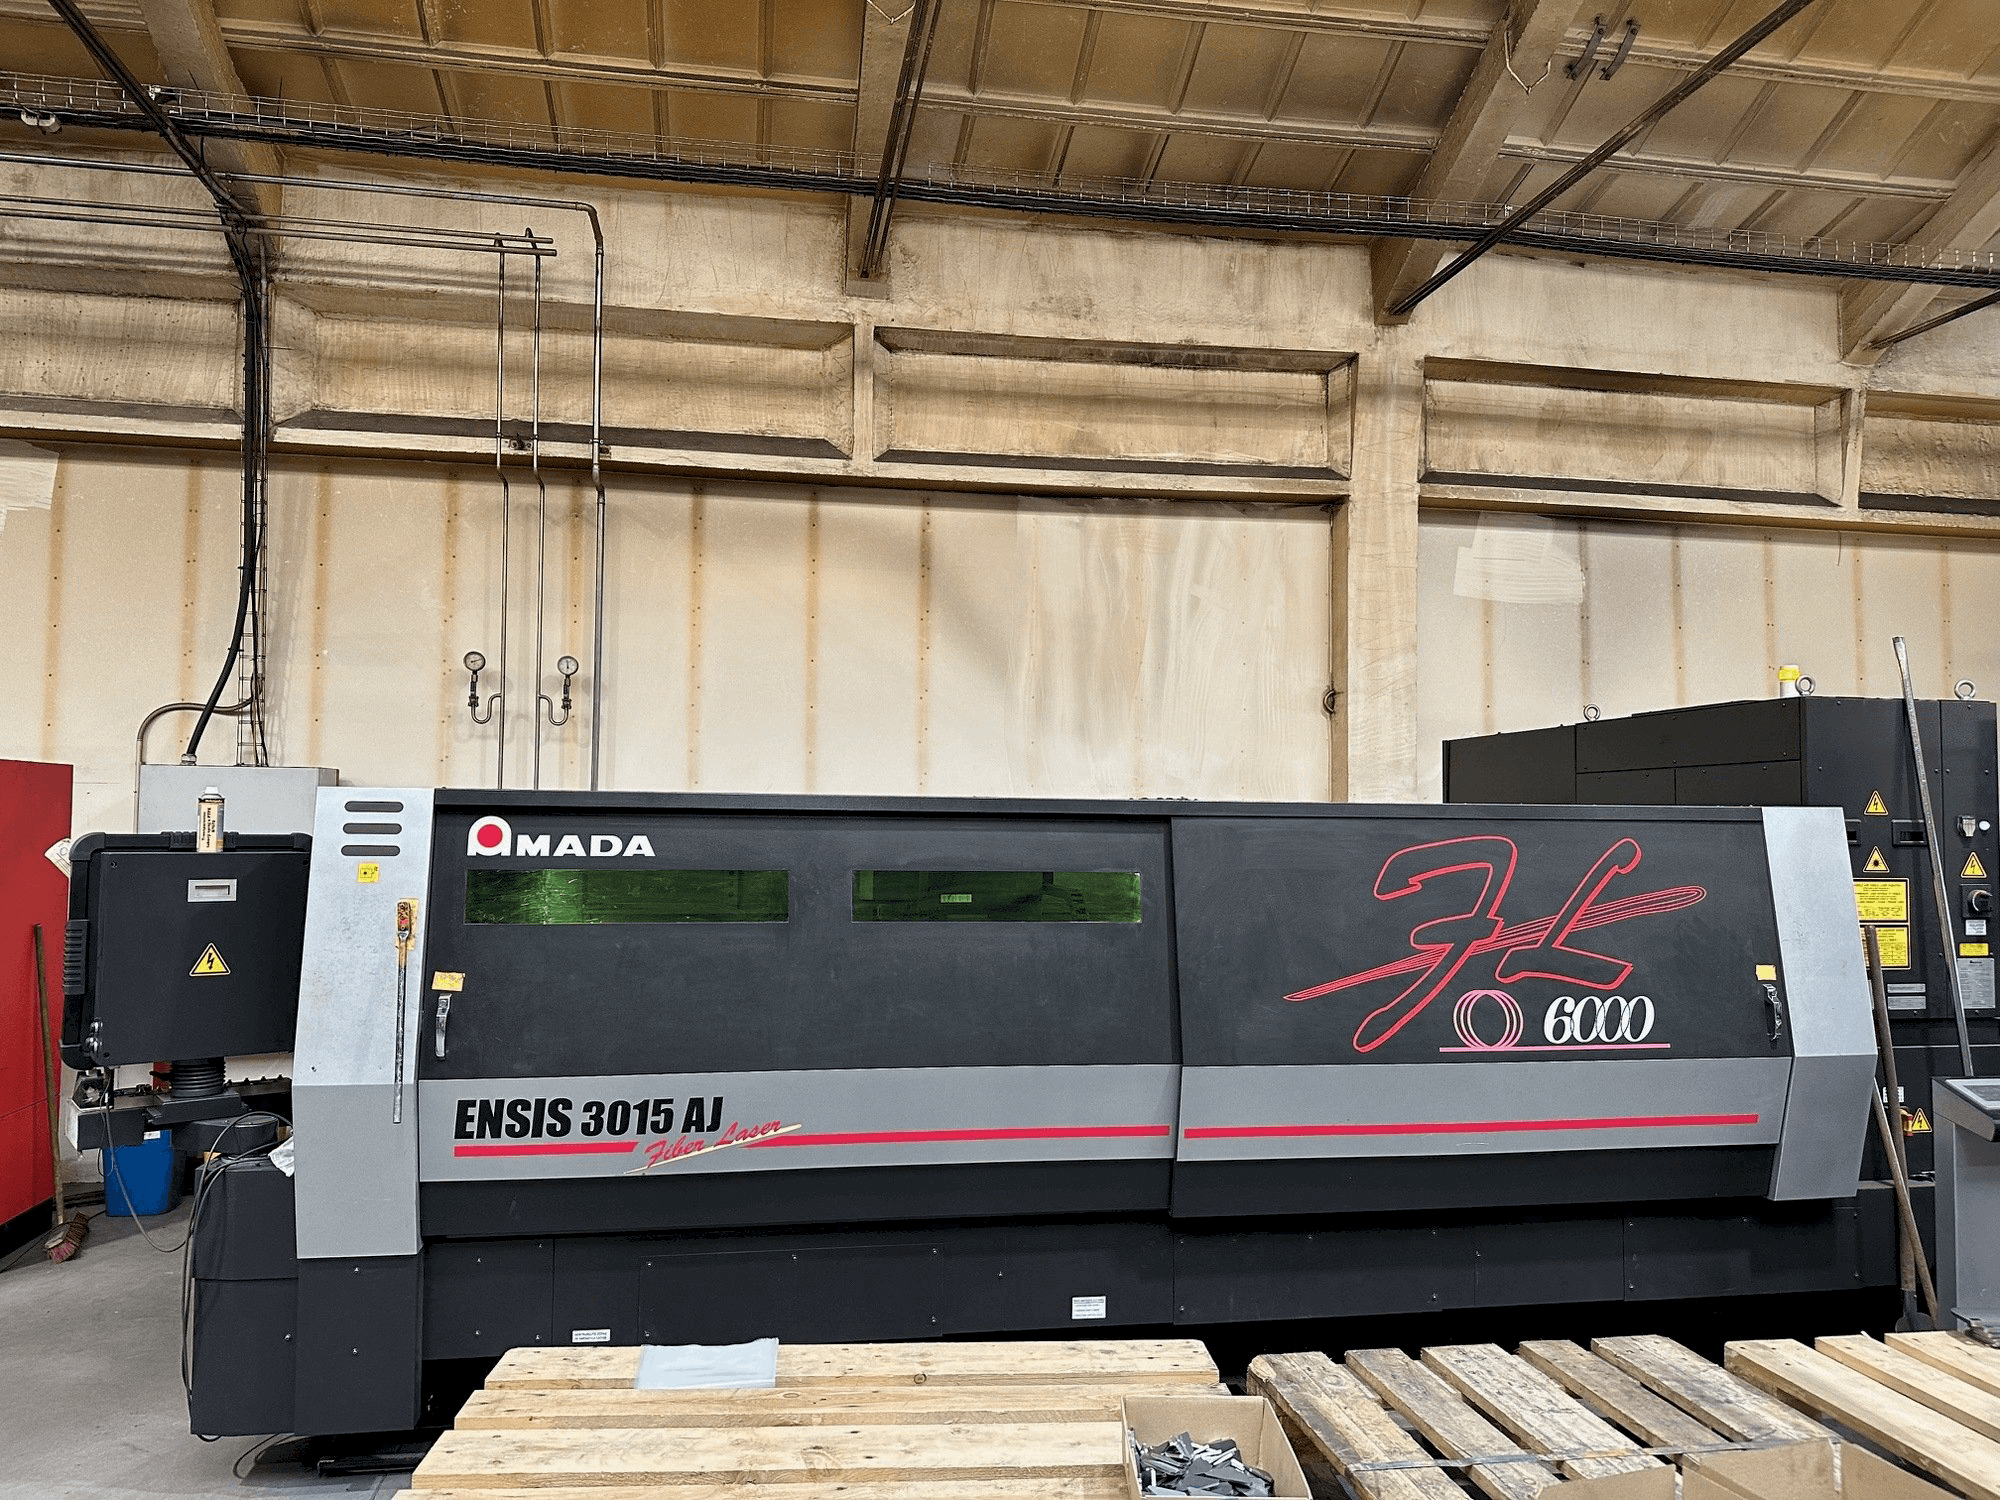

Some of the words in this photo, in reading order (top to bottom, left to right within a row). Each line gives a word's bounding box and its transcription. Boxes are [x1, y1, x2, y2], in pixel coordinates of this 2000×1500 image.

[466, 815, 656, 857] AMADA
[1544, 995, 1656, 1045] 6000
[454, 1098, 573, 1140] ENSIS
[580, 1097, 675, 1137] 3015
[680, 1096, 724, 1133] AJ
[644, 1136, 705, 1169] Fiber
[714, 1120, 782, 1147] Laser
